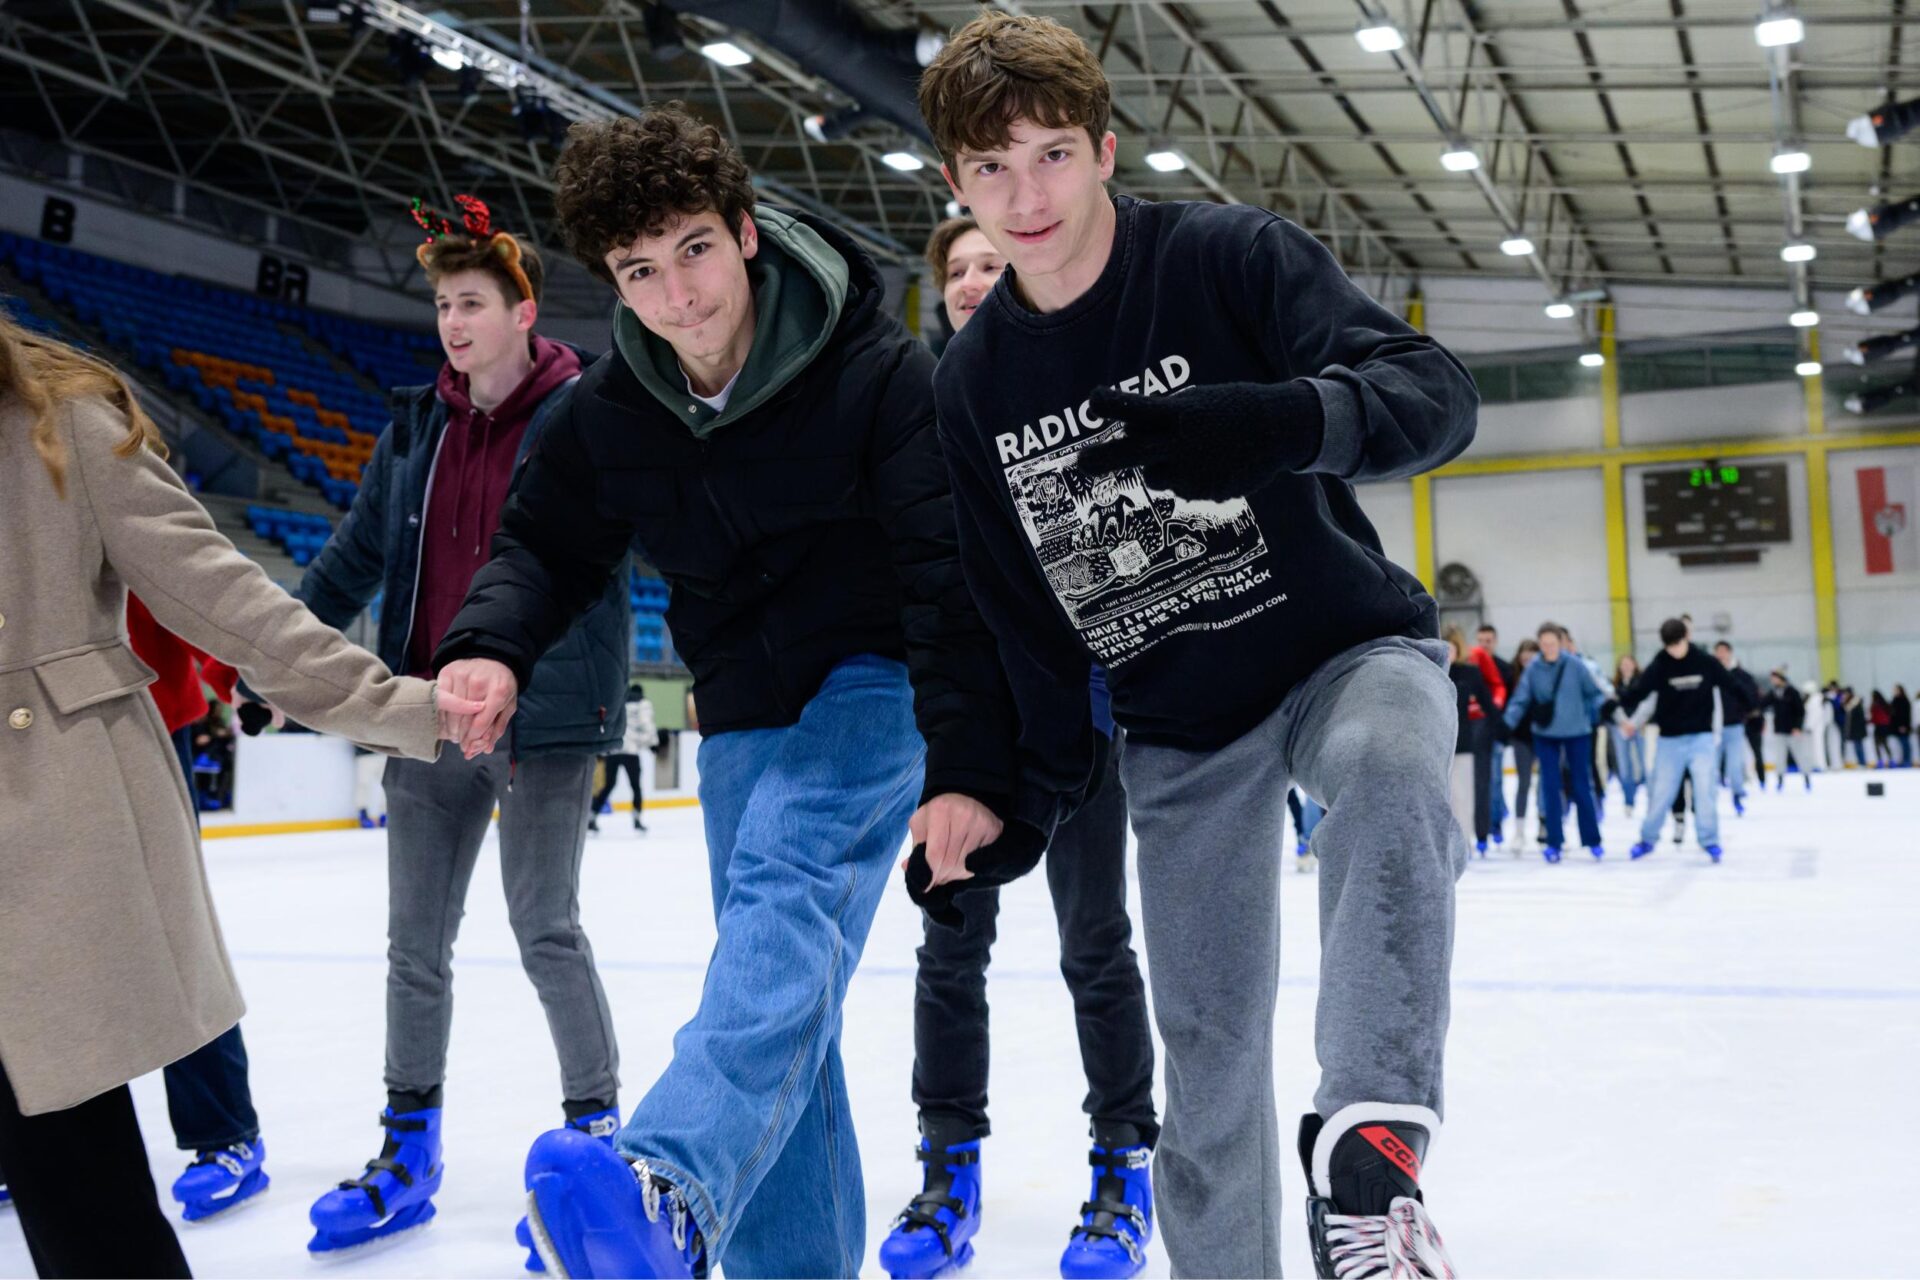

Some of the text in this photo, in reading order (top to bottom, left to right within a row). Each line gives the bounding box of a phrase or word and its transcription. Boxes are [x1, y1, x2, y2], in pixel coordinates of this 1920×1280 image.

[41, 196, 76, 244] B
[995, 354, 1190, 464] RADIOEAD
[1101, 505, 1116, 516] SPIN
[1081, 632, 1087, 641] I
[1086, 621, 1121, 640] HAVE
[1123, 616, 1133, 627] A
[1134, 597, 1180, 621] PAPER
[1181, 577, 1216, 599] HERE
[1219, 565, 1254, 587] THAT
[1087, 623, 1147, 651] ENTITLES
[1149, 612, 1170, 626] ME
[1170, 601, 1190, 615] TO
[1192, 589, 1221, 603] FAST
[1224, 569, 1272, 598] TRACK
[1106, 656, 1128, 669] ASTE
[1202, 622, 1210, 631] OF
[1212, 604, 1264, 631] RADIOHEAD
[1265, 593, 1288, 607] COM
